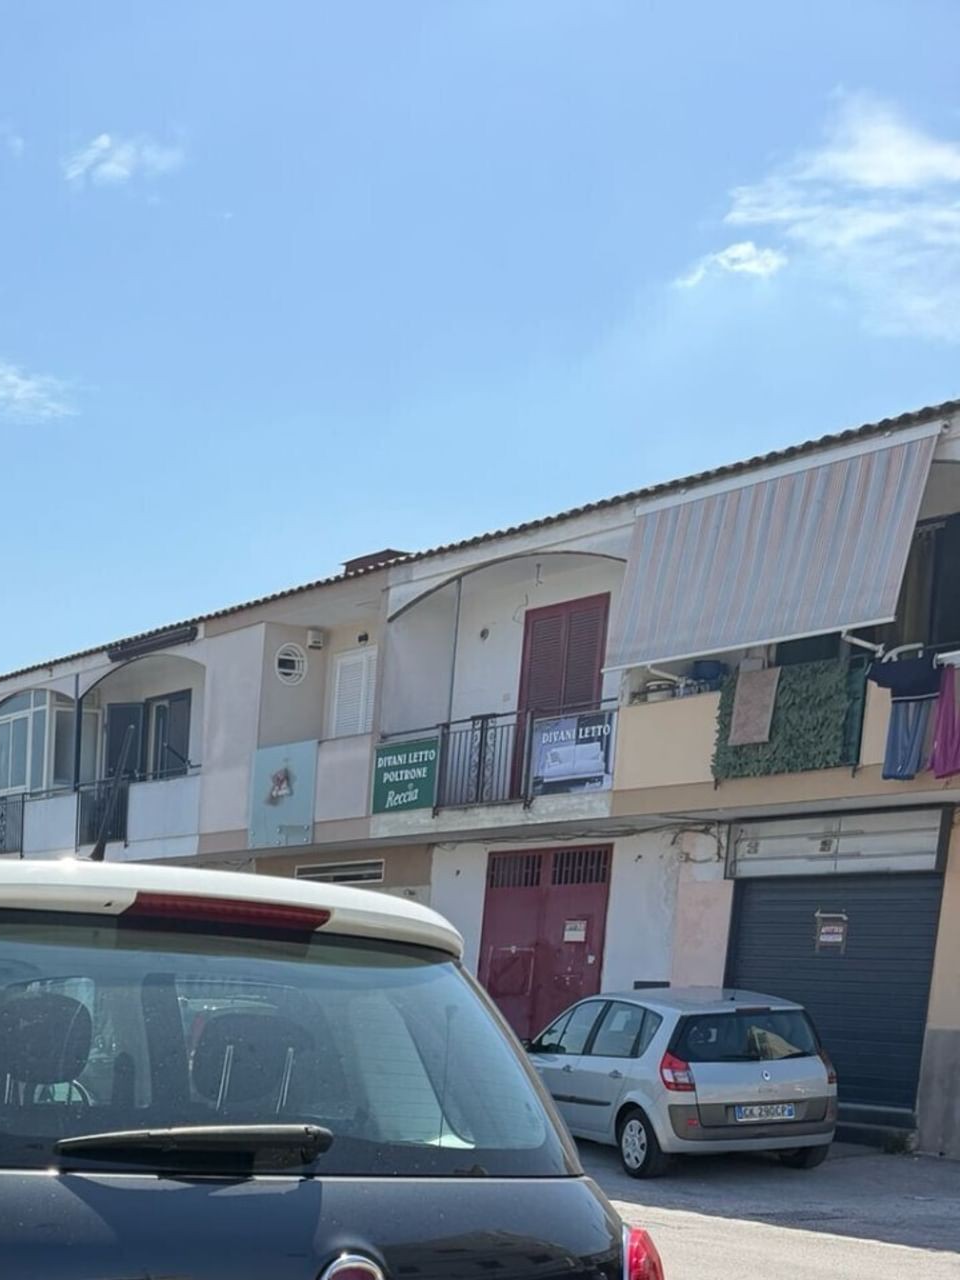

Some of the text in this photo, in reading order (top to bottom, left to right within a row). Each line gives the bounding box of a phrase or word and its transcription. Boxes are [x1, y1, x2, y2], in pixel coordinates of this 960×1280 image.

[542, 724, 611, 744] DIVANI LETTO
[377, 749, 436, 768] DIVANI LETTO
[382, 767, 428, 784] POLTRONE
